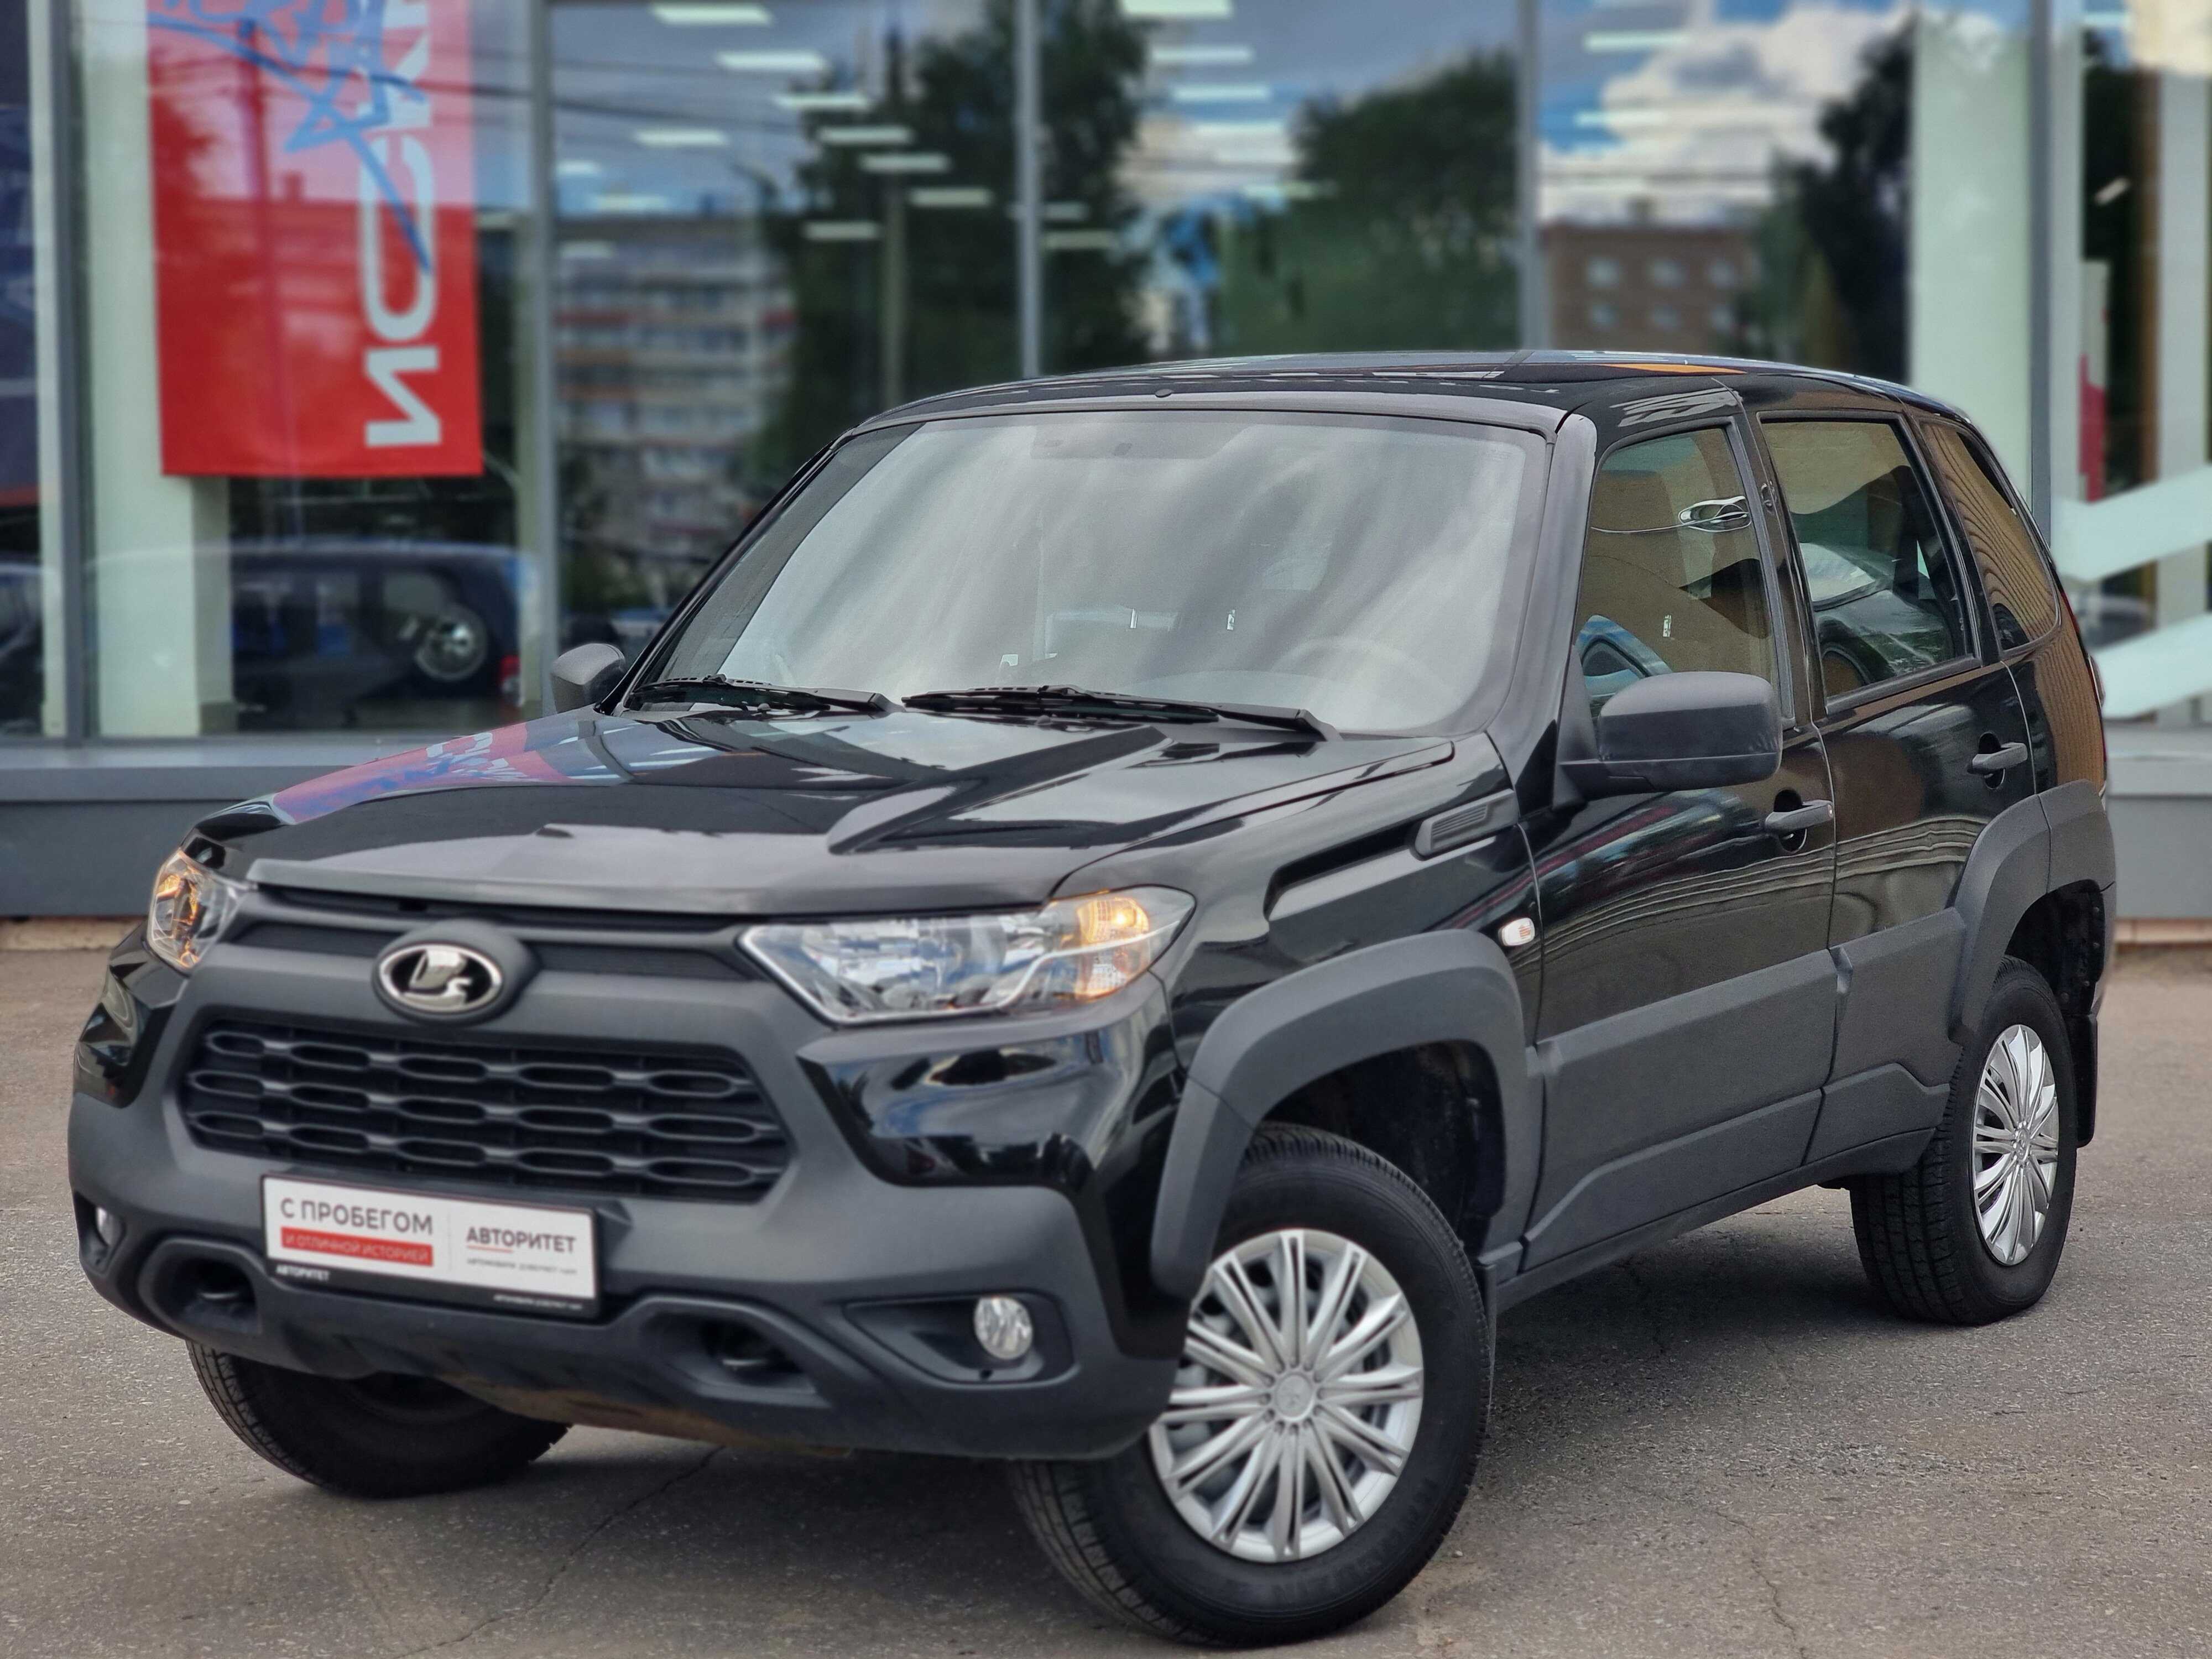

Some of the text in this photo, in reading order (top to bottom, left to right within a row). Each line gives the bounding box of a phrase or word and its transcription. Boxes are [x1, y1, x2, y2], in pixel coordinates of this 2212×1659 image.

[281, 1198, 433, 1235] С ПРОБЕГОМ
[298, 1235, 359, 1254] ОТЛИЧНОЙ
[362, 1243, 429, 1262] ИСТОРИЕЙ
[467, 1227, 576, 1253] АВТОРИТЕТ
